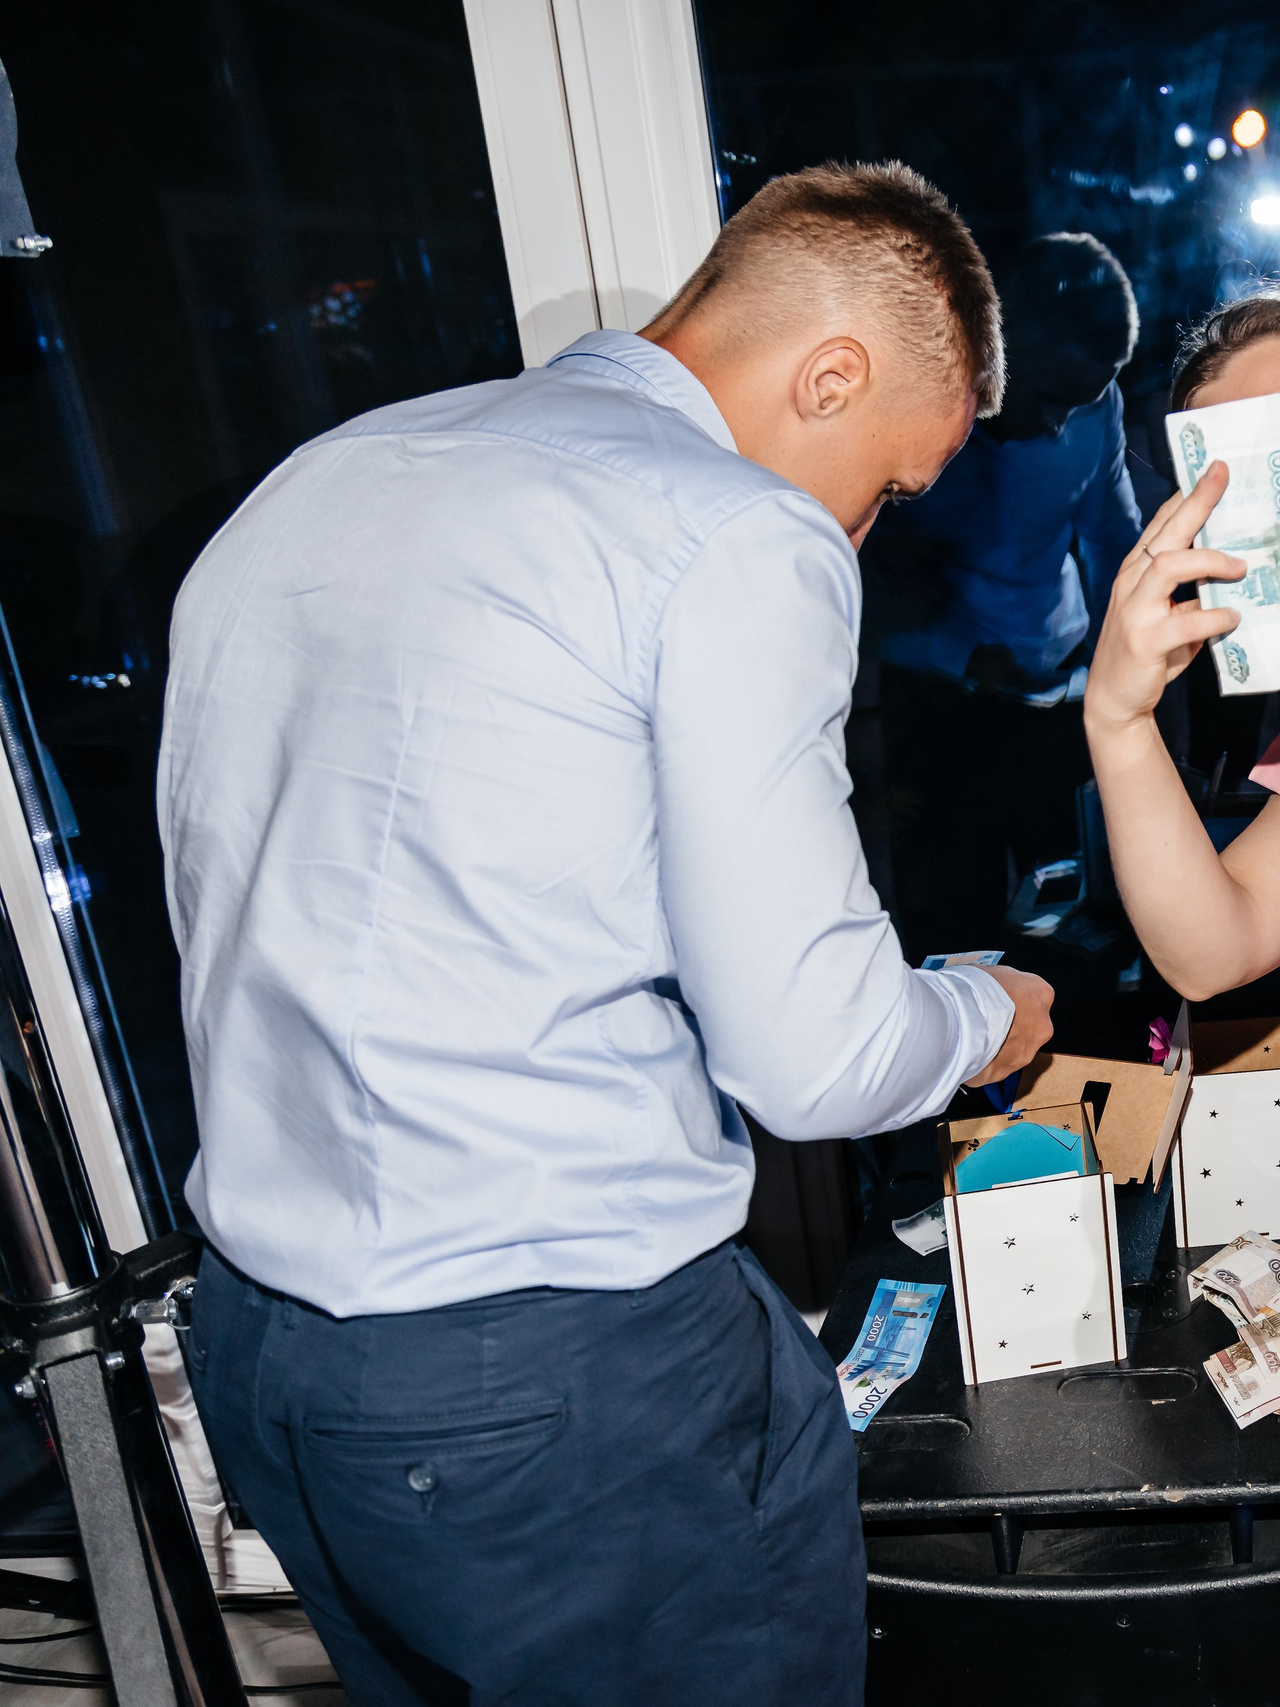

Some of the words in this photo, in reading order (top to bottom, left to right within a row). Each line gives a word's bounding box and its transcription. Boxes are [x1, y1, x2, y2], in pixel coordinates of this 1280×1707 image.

[1182, 430, 1199, 465] 1000
[1227, 649, 1242, 677] 1000
[1217, 1270, 1240, 1285] 500
[866, 1314, 885, 1342] 2000
[1265, 1352, 1278, 1373] 100
[852, 1386, 888, 1419] 2000
